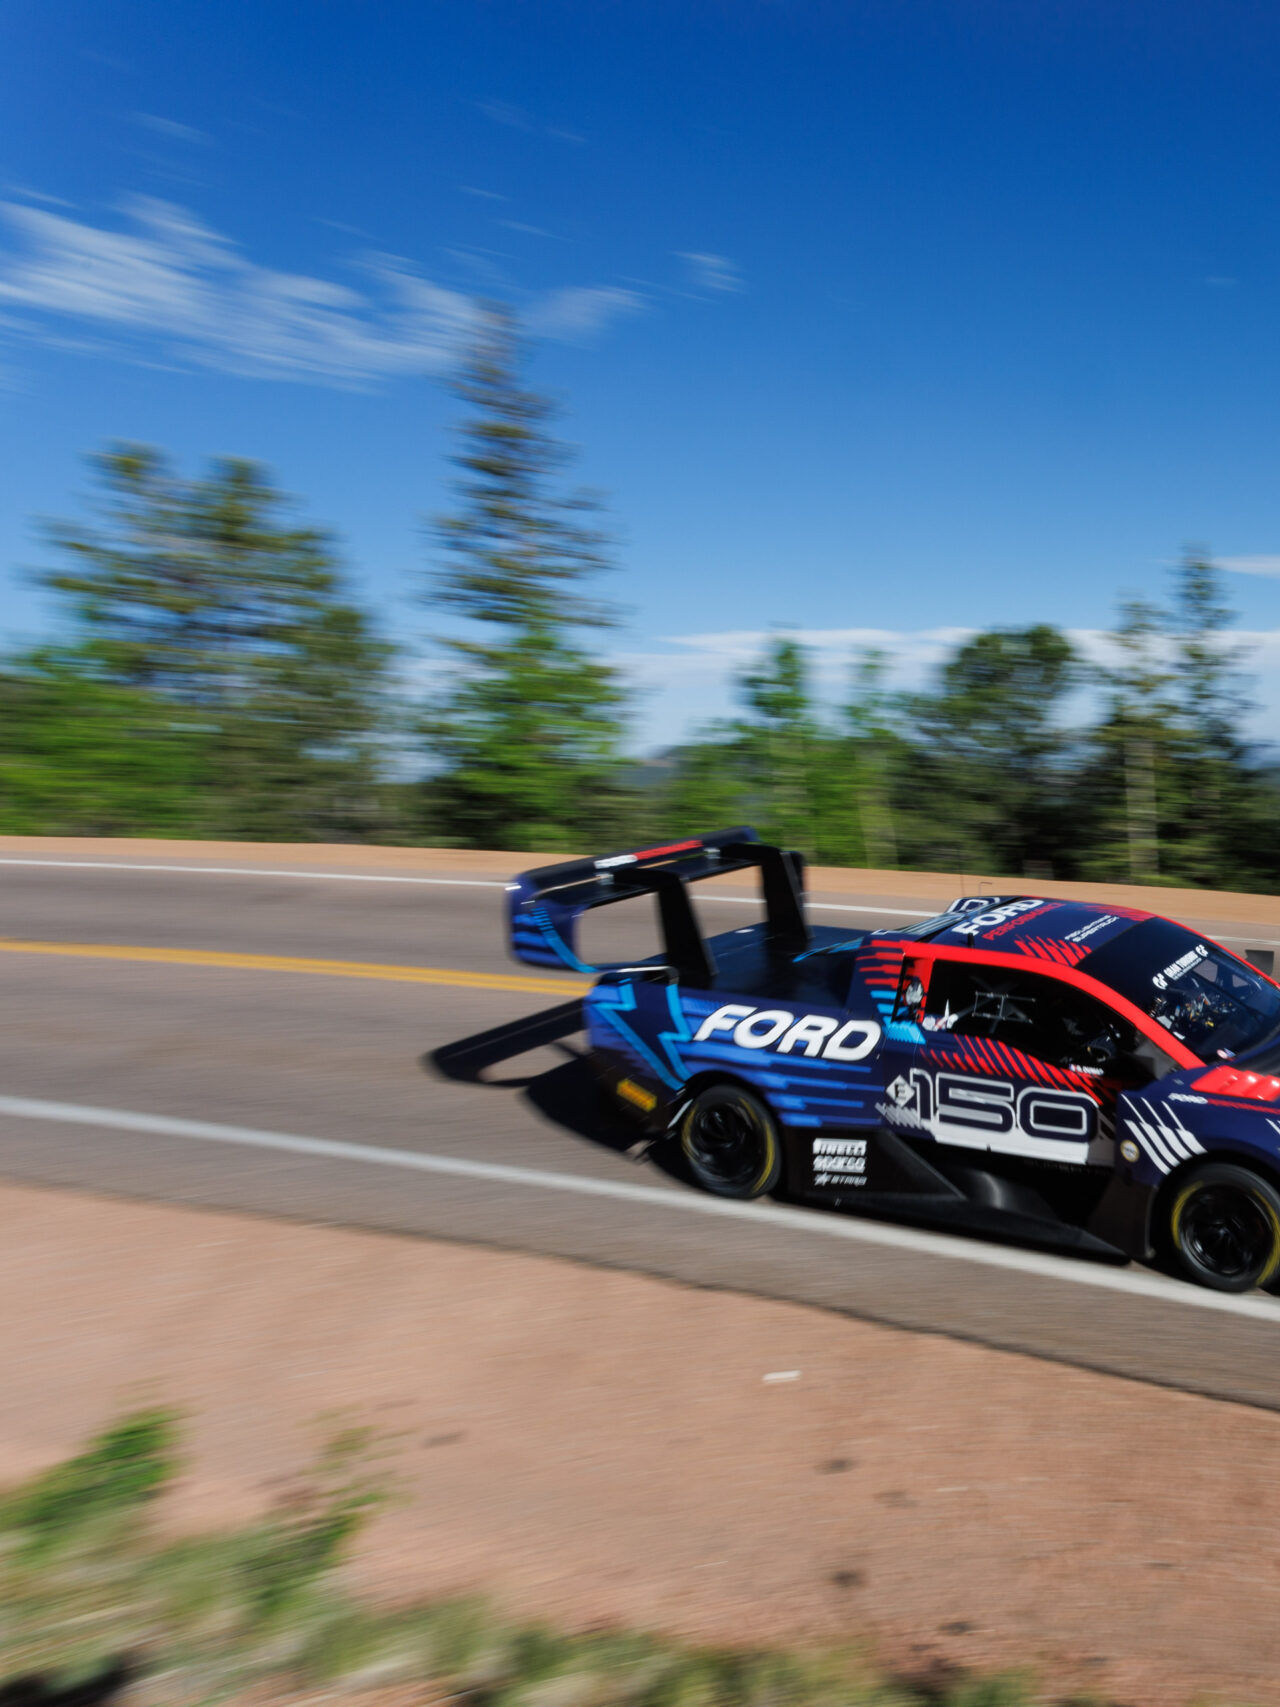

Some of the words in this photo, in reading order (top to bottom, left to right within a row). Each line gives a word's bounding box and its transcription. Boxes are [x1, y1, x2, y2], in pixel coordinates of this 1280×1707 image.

[952, 899, 1044, 936] FORD
[693, 1004, 882, 1061] FORD
[910, 1068, 1100, 1144] 150
